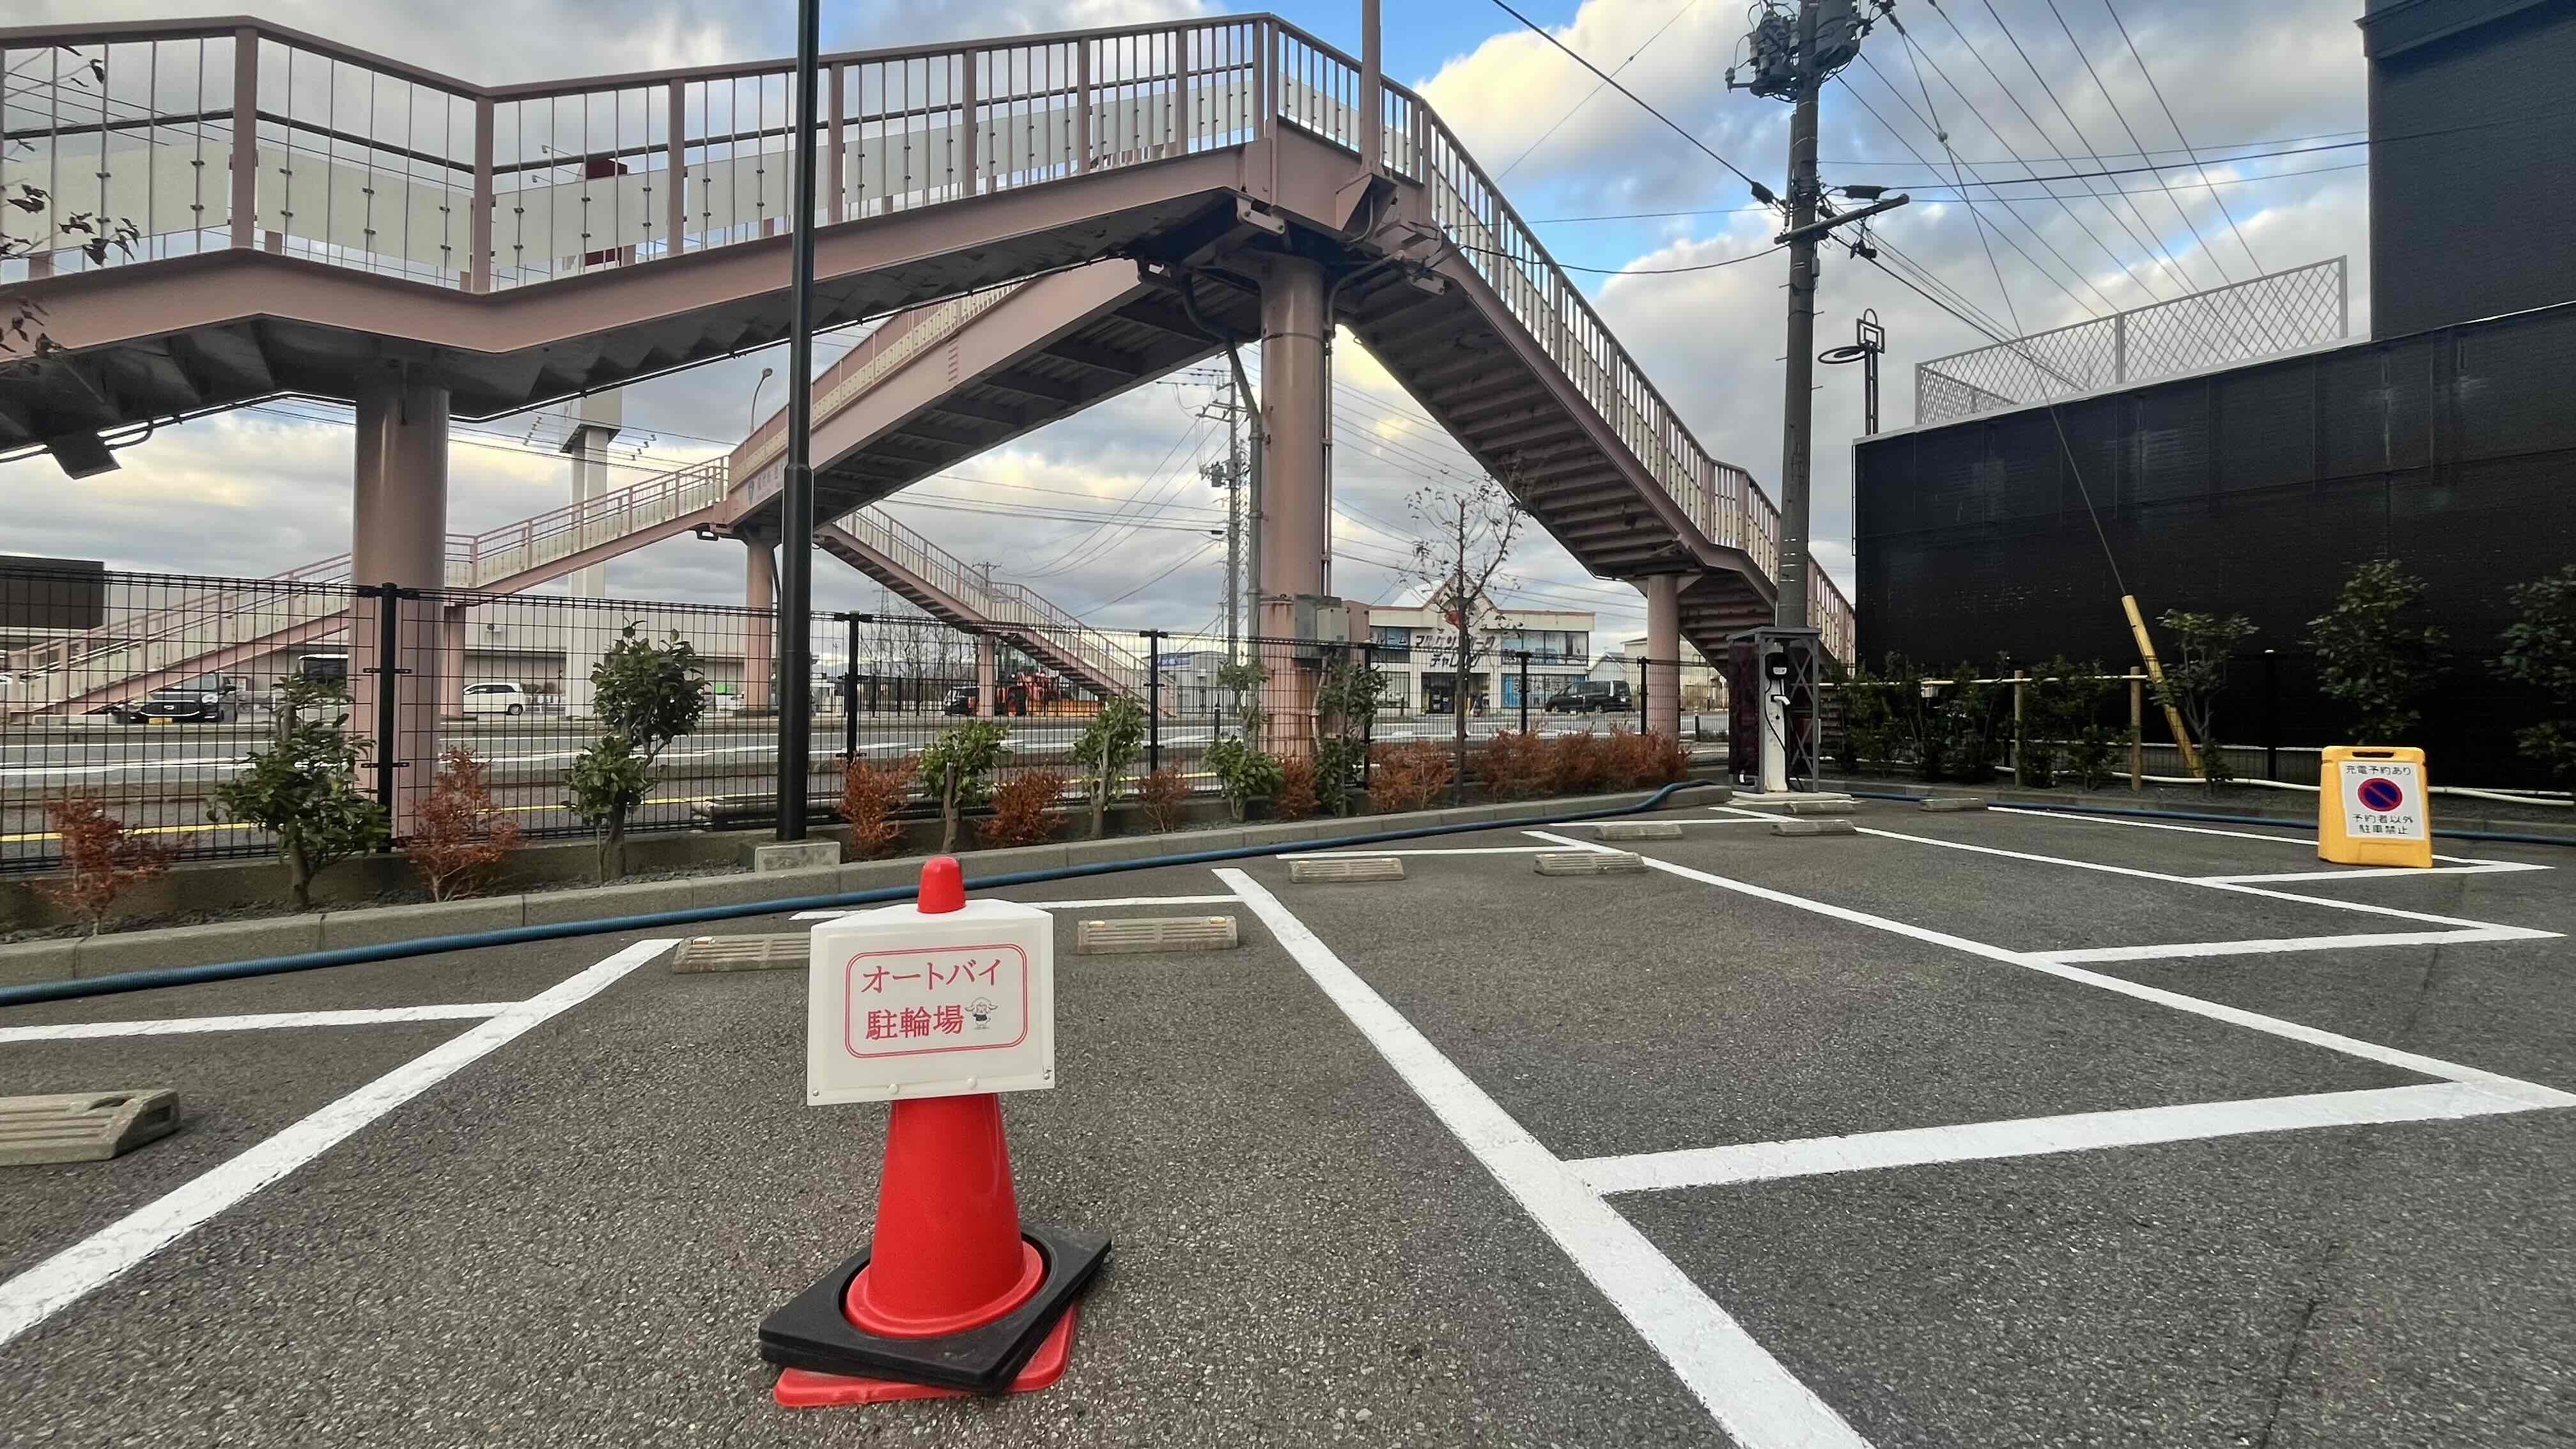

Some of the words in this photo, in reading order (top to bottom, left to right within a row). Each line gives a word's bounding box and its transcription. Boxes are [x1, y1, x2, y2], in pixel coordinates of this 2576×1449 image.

[2346, 765, 2412, 775] 充電予約あり
[2352, 813, 2414, 824] 予約者以外
[2359, 824, 2409, 835] 駐車禁止
[860, 958, 1002, 994] オートバイ
[865, 1003, 965, 1041] 駐輪場
